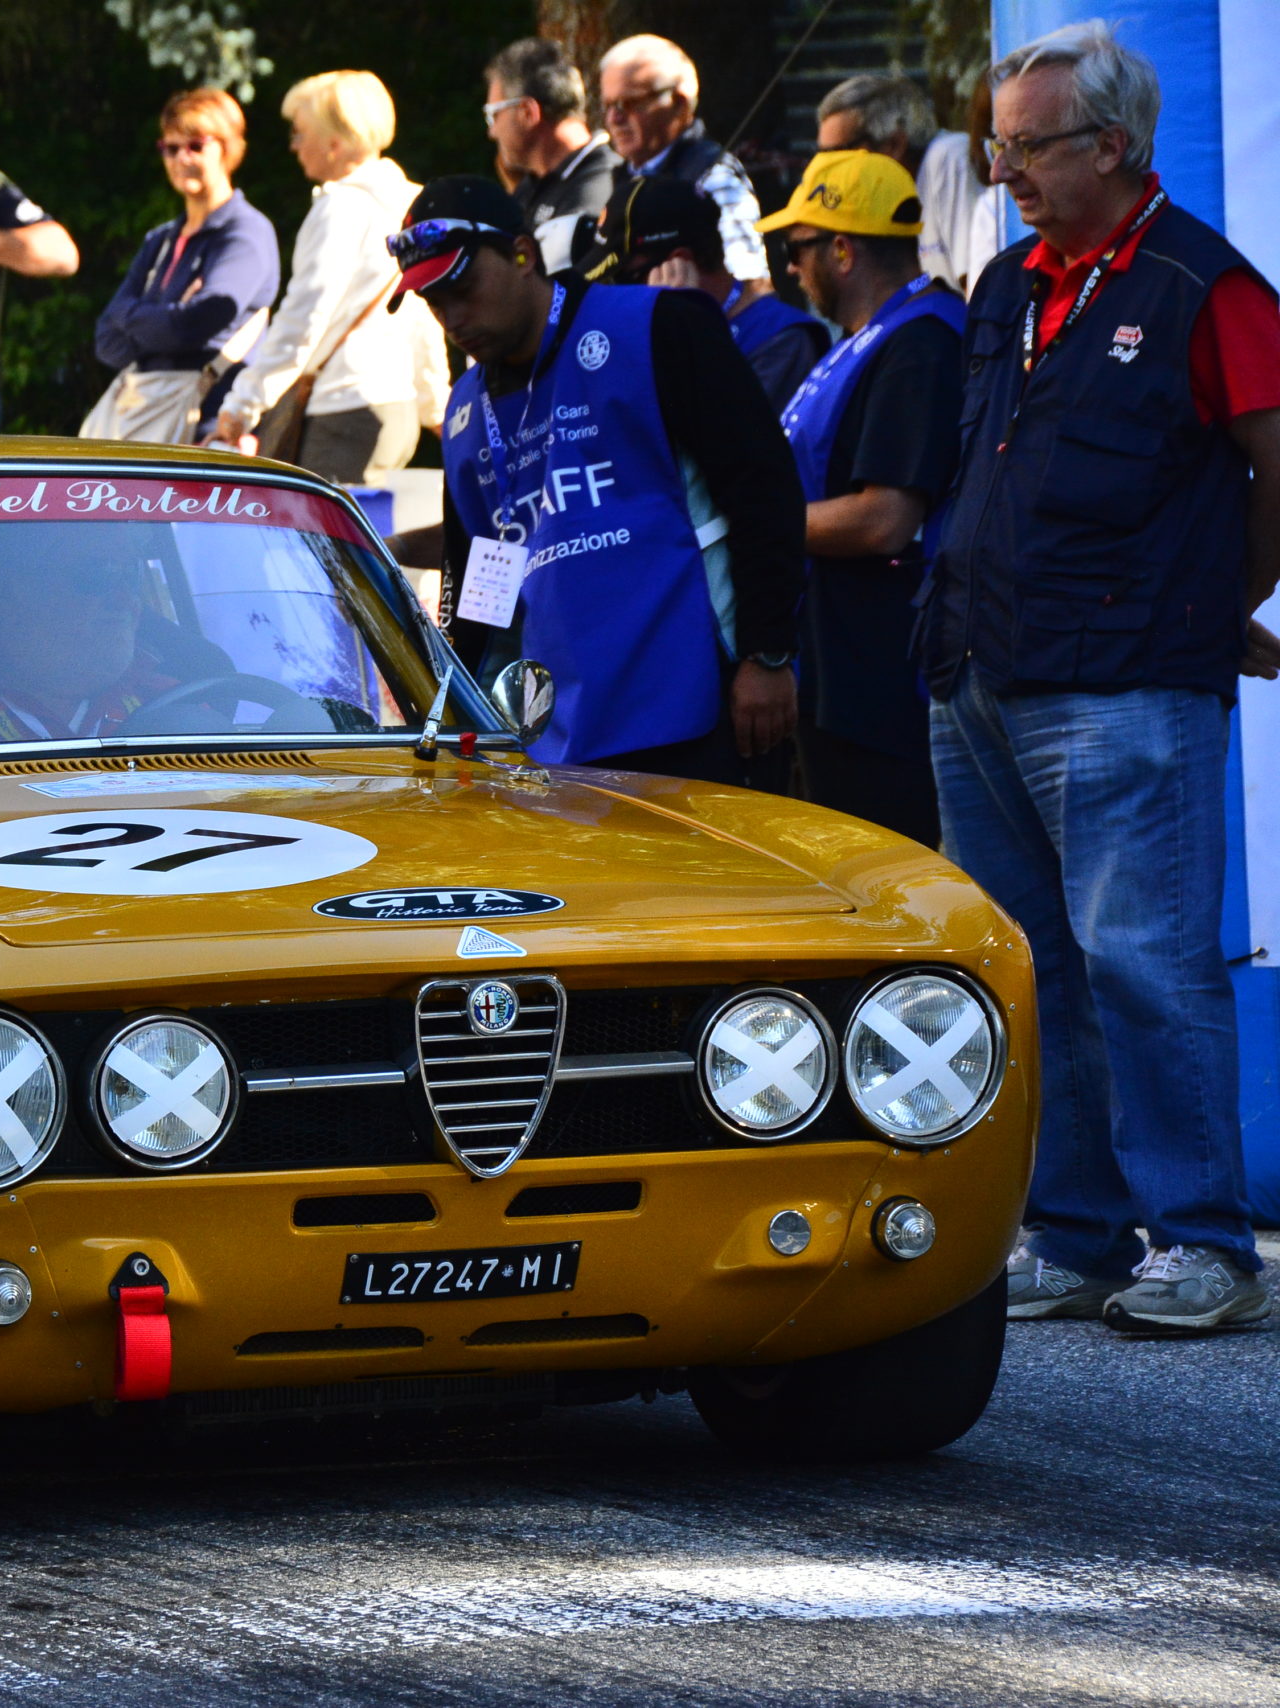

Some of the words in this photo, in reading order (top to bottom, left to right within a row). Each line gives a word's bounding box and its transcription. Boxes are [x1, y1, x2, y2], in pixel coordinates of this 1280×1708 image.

[1066, 266, 1102, 325] ABARTH
[1022, 300, 1037, 351] ABARTH
[556, 403, 590, 420] Gara
[557, 424, 600, 442] Torino
[65, 480, 272, 518] Portello
[492, 461, 615, 547] STAFF
[349, 890, 524, 908] GTA
[376, 905, 466, 919] Historic
[474, 903, 528, 914] Team
[490, 986, 513, 1005] ROMEO
[480, 1017, 510, 1029] MILANO
[364, 1258, 500, 1296] L27247
